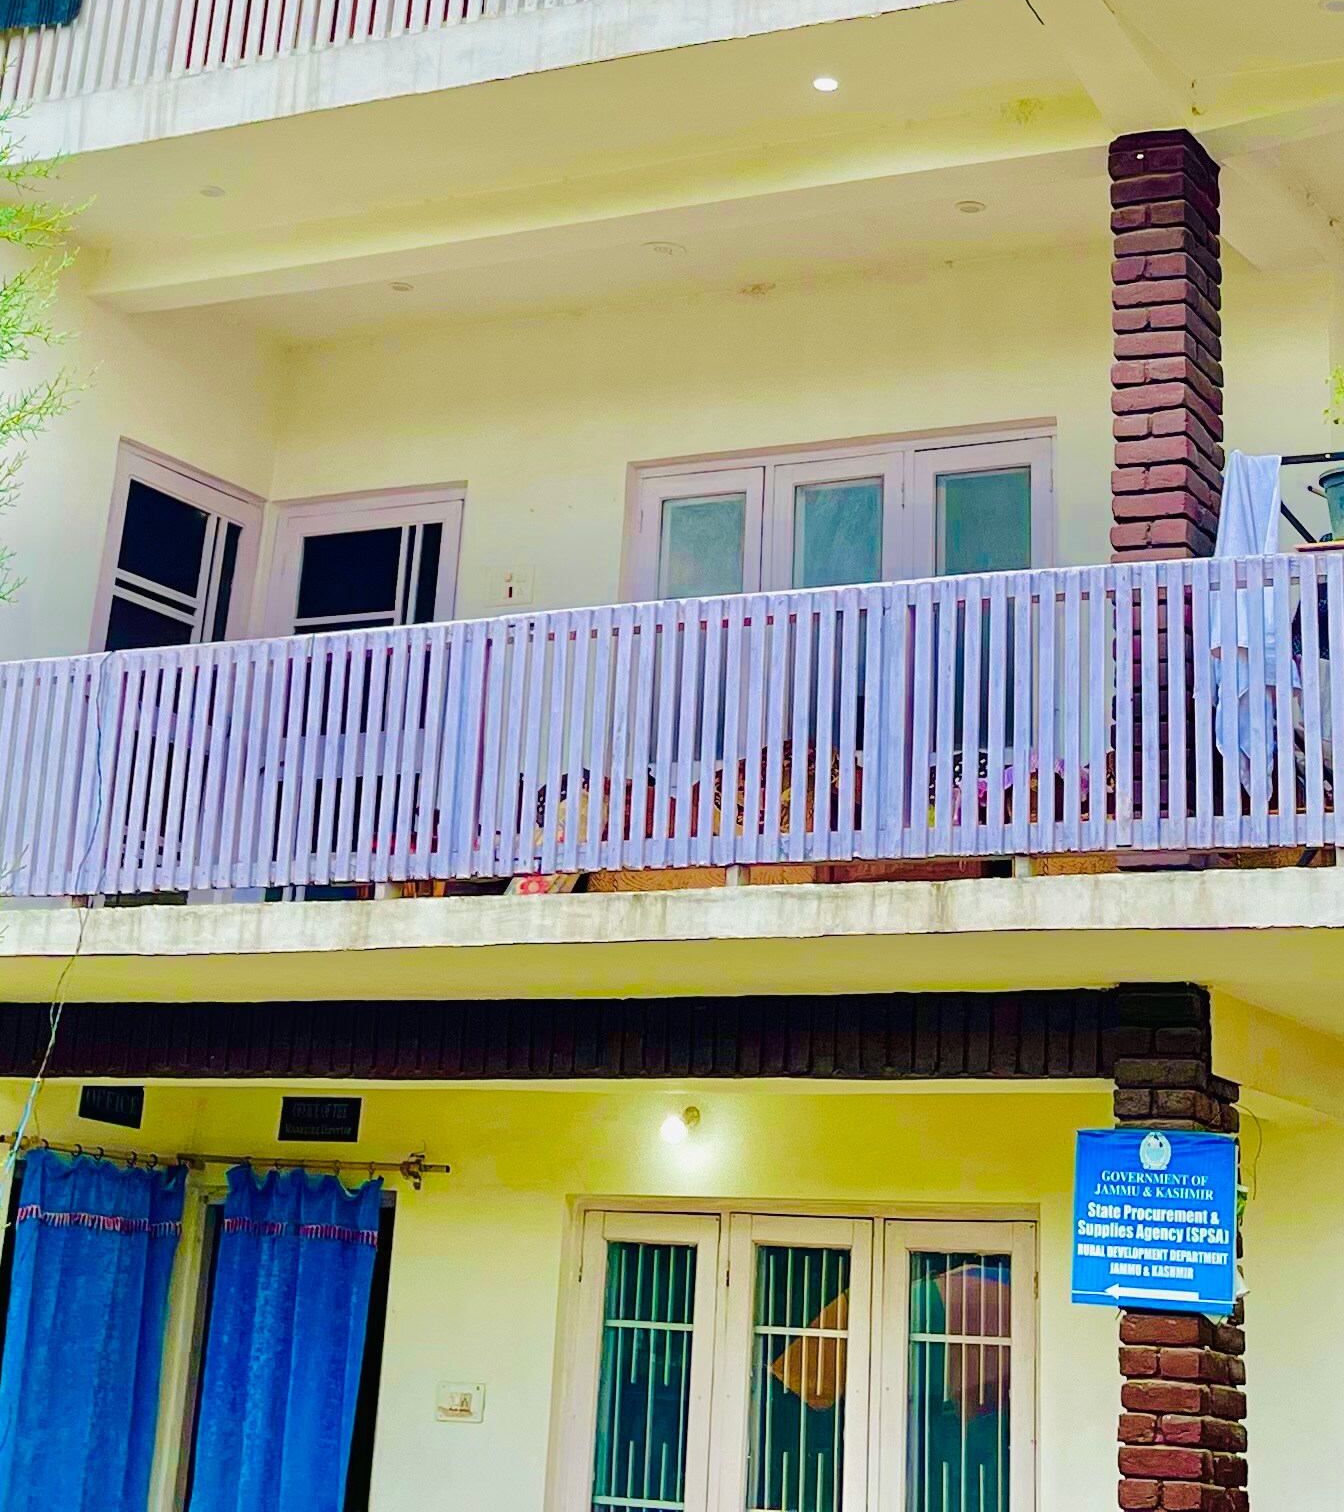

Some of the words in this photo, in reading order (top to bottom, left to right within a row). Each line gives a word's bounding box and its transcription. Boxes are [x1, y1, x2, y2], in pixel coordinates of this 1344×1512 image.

[1101, 1170, 1189, 1185] GOVERNMENT
[1191, 1175, 1209, 1185] OF
[1094, 1184, 1140, 1196] JAMMU
[1142, 1187, 1153, 1197] &
[1155, 1187, 1214, 1201] KASHMIR
[1087, 1201, 1121, 1219] State
[1123, 1205, 1208, 1224] Procurement
[1210, 1211, 1220, 1225] &
[1077, 1220, 1134, 1239] Supplies
[1136, 1224, 1183, 1243] Agency
[1186, 1226, 1230, 1244] (SPSA)
[1077, 1243, 1106, 1257] RURAL
[1107, 1245, 1169, 1261] DEVELOPMENT
[1170, 1248, 1229, 1265] DEPARTMENT
[1110, 1262, 1142, 1277] JAMMU
[1143, 1265, 1151, 1277] &
[1151, 1264, 1195, 1280] KASHMIR
